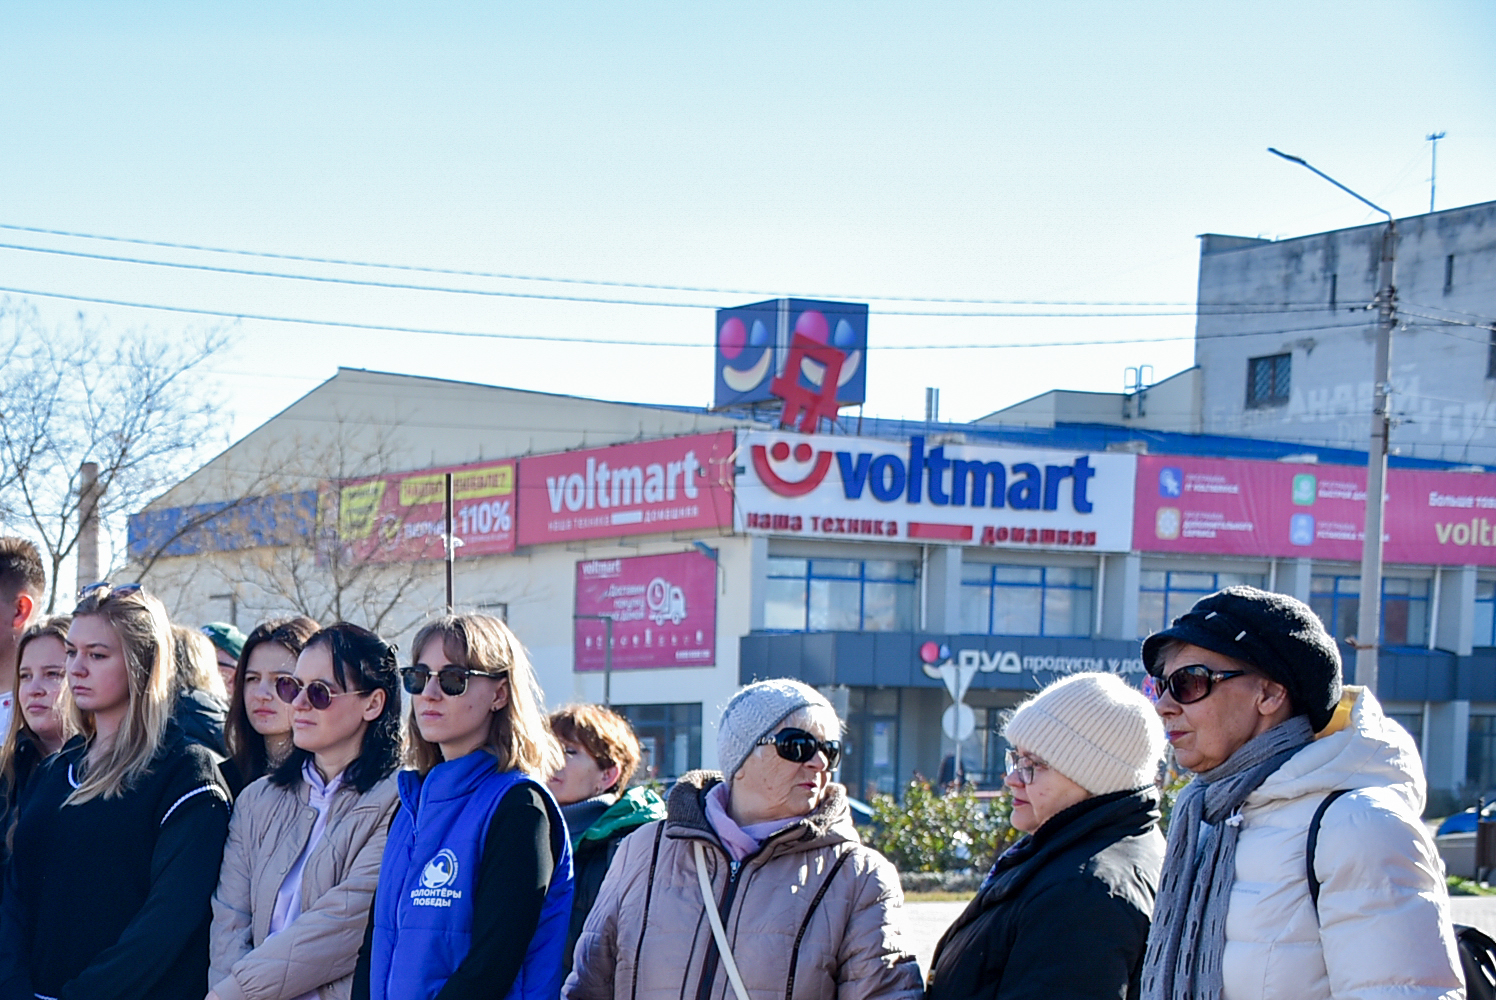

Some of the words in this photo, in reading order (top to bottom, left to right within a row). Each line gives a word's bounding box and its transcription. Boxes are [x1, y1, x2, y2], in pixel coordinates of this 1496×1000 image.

[546, 450, 699, 513] voltmart
[836, 436, 1096, 514] voltmart
[458, 500, 512, 535] 110%
[747, 512, 803, 532] наша
[811, 514, 898, 537] техника
[981, 525, 1098, 547] домашняя
[1434, 517, 1496, 547] volt
[1023, 656, 1104, 674] продукты
[1121, 659, 1144, 674] до
[413, 898, 452, 907] ПОБЕДЫ
